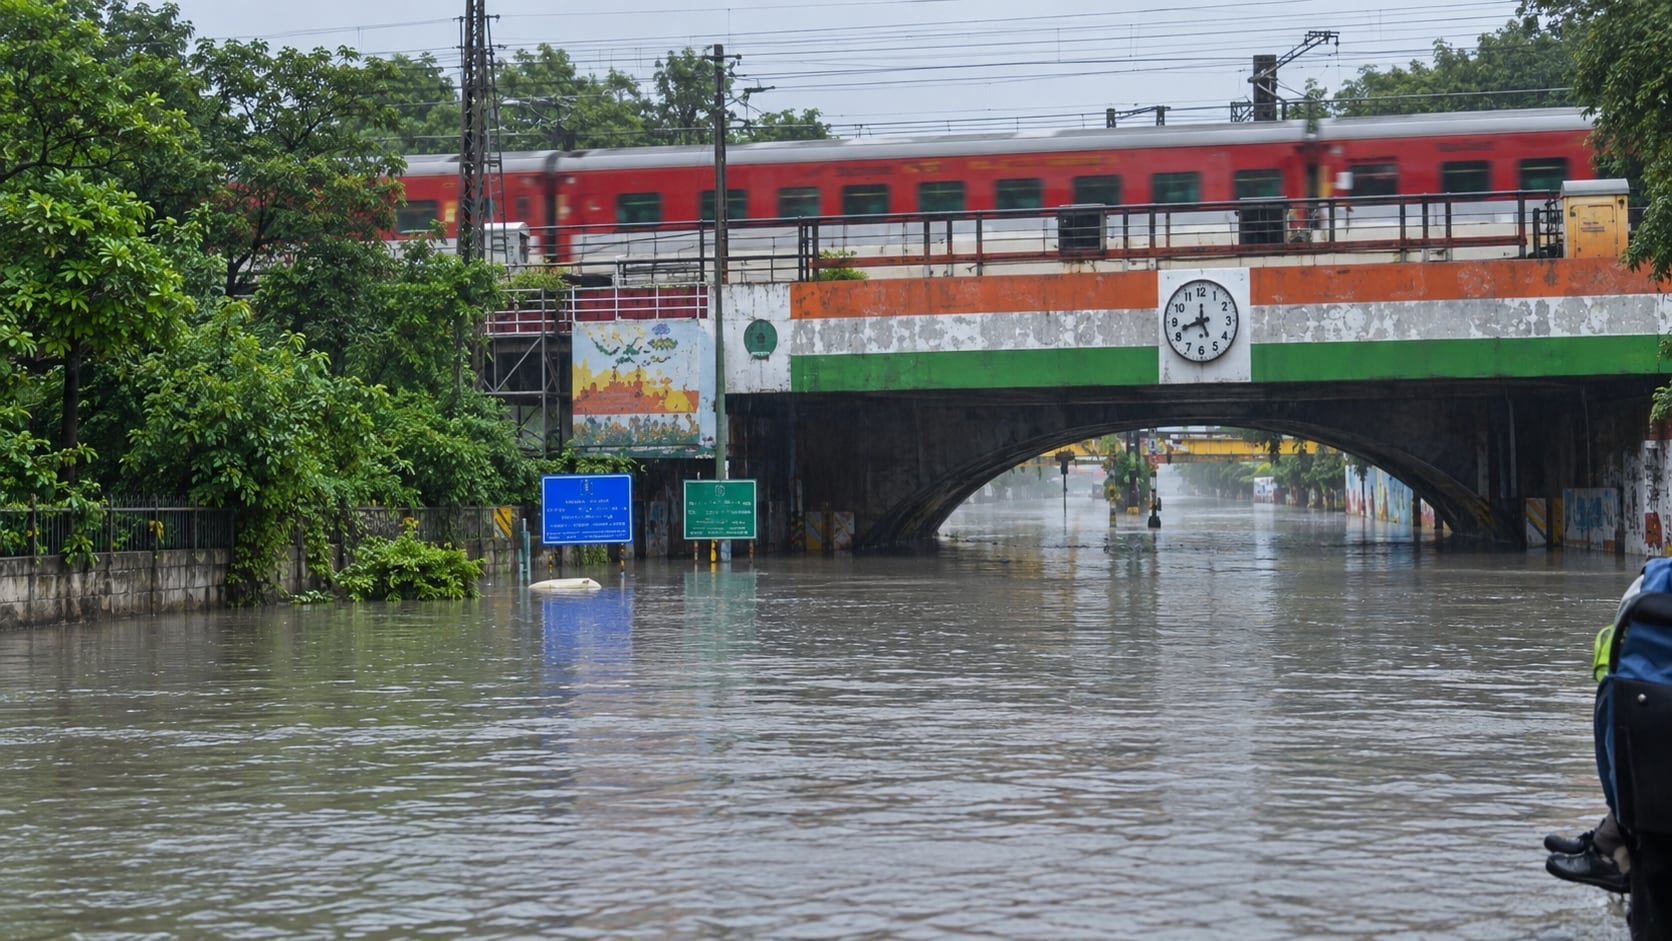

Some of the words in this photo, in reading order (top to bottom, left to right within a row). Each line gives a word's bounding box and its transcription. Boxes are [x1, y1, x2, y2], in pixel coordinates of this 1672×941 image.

[1185, 292, 1192, 302] 11
[1196, 288, 1206, 297] 12
[1213, 291, 1216, 301] 1
[1175, 303, 1185, 313] 10
[1222, 302, 1228, 311] 2
[1172, 317, 1178, 327] 9
[1226, 316, 1231, 326] 3
[1176, 332, 1182, 342] 8
[1221, 331, 1228, 340] 4
[1186, 342, 1192, 352] 7
[1198, 346, 1204, 355] 6
[1212, 341, 1218, 351] 5
